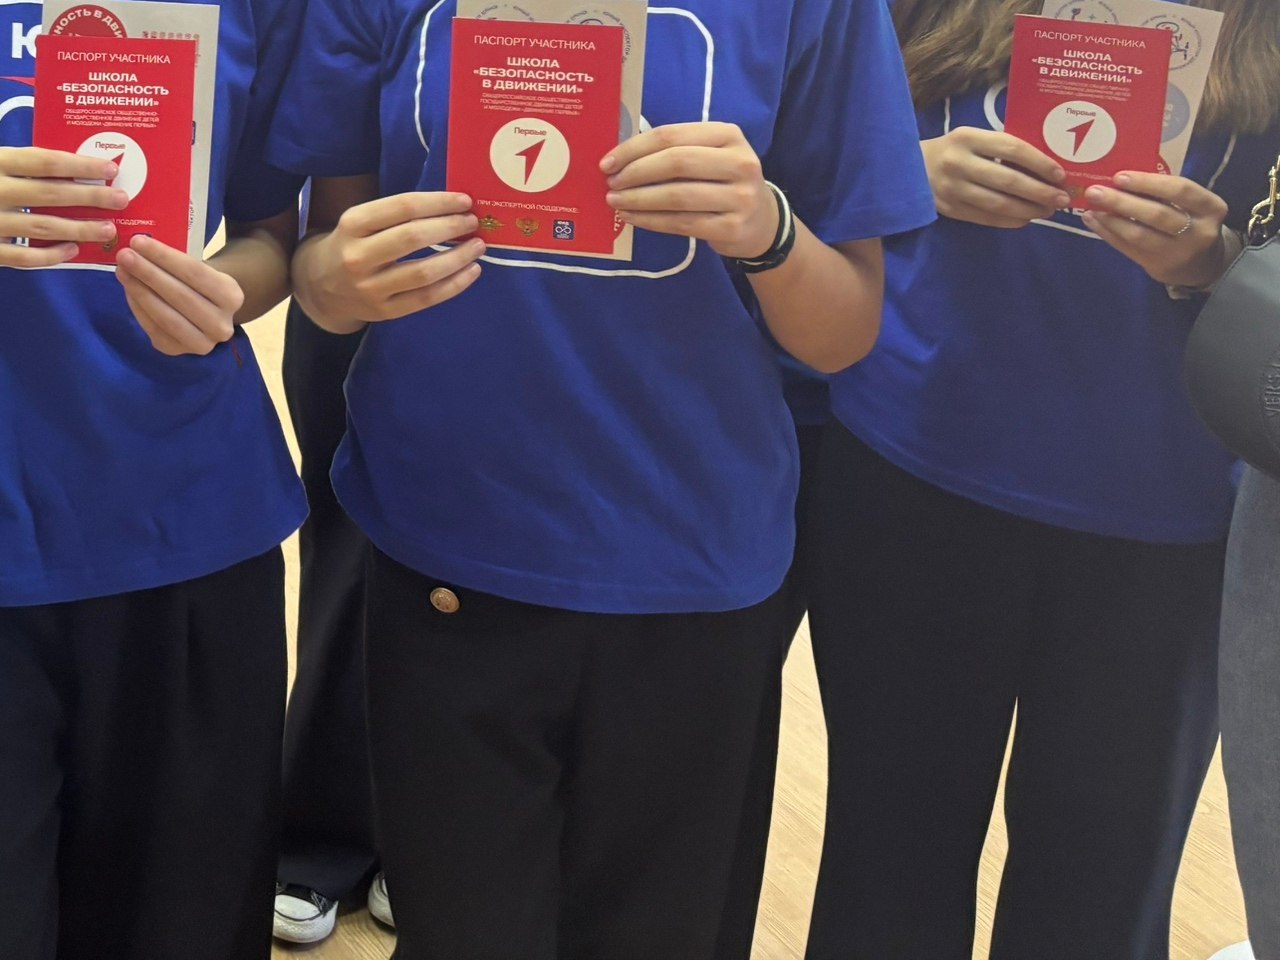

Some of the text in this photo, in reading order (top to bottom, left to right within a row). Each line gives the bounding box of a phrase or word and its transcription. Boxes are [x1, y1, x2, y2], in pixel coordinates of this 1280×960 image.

[53, 8, 92, 36] НОСТЬ
[94, 9, 103, 19] В
[474, 35, 596, 50] ПАСПОРТ УЧАСТНИКА
[1034, 30, 1146, 48] ПАСПОРТ УЧАСТНИКА
[57, 51, 171, 64] ПАСПОРТ УЧАСТНИКА
[507, 57, 560, 68] ШКОЛА
[1063, 49, 1112, 62] ШКОЛА
[1032, 56, 1143, 75] «БЕЗОПАСНОСТЬ
[88, 72, 138, 82] ШКОЛА
[473, 67, 594, 82] «БЕЗОПАСНОСТЬ
[1050, 68, 1132, 83] ДВИЖЕНИИ»
[56, 82, 169, 96] «БЕЗОПАСНОСТЬ
[482, 79, 583, 93] В ДВИЖЕНИИ»
[65, 95, 159, 107] В ДВИЖЕНИИ»
[514, 127, 547, 136] Первые
